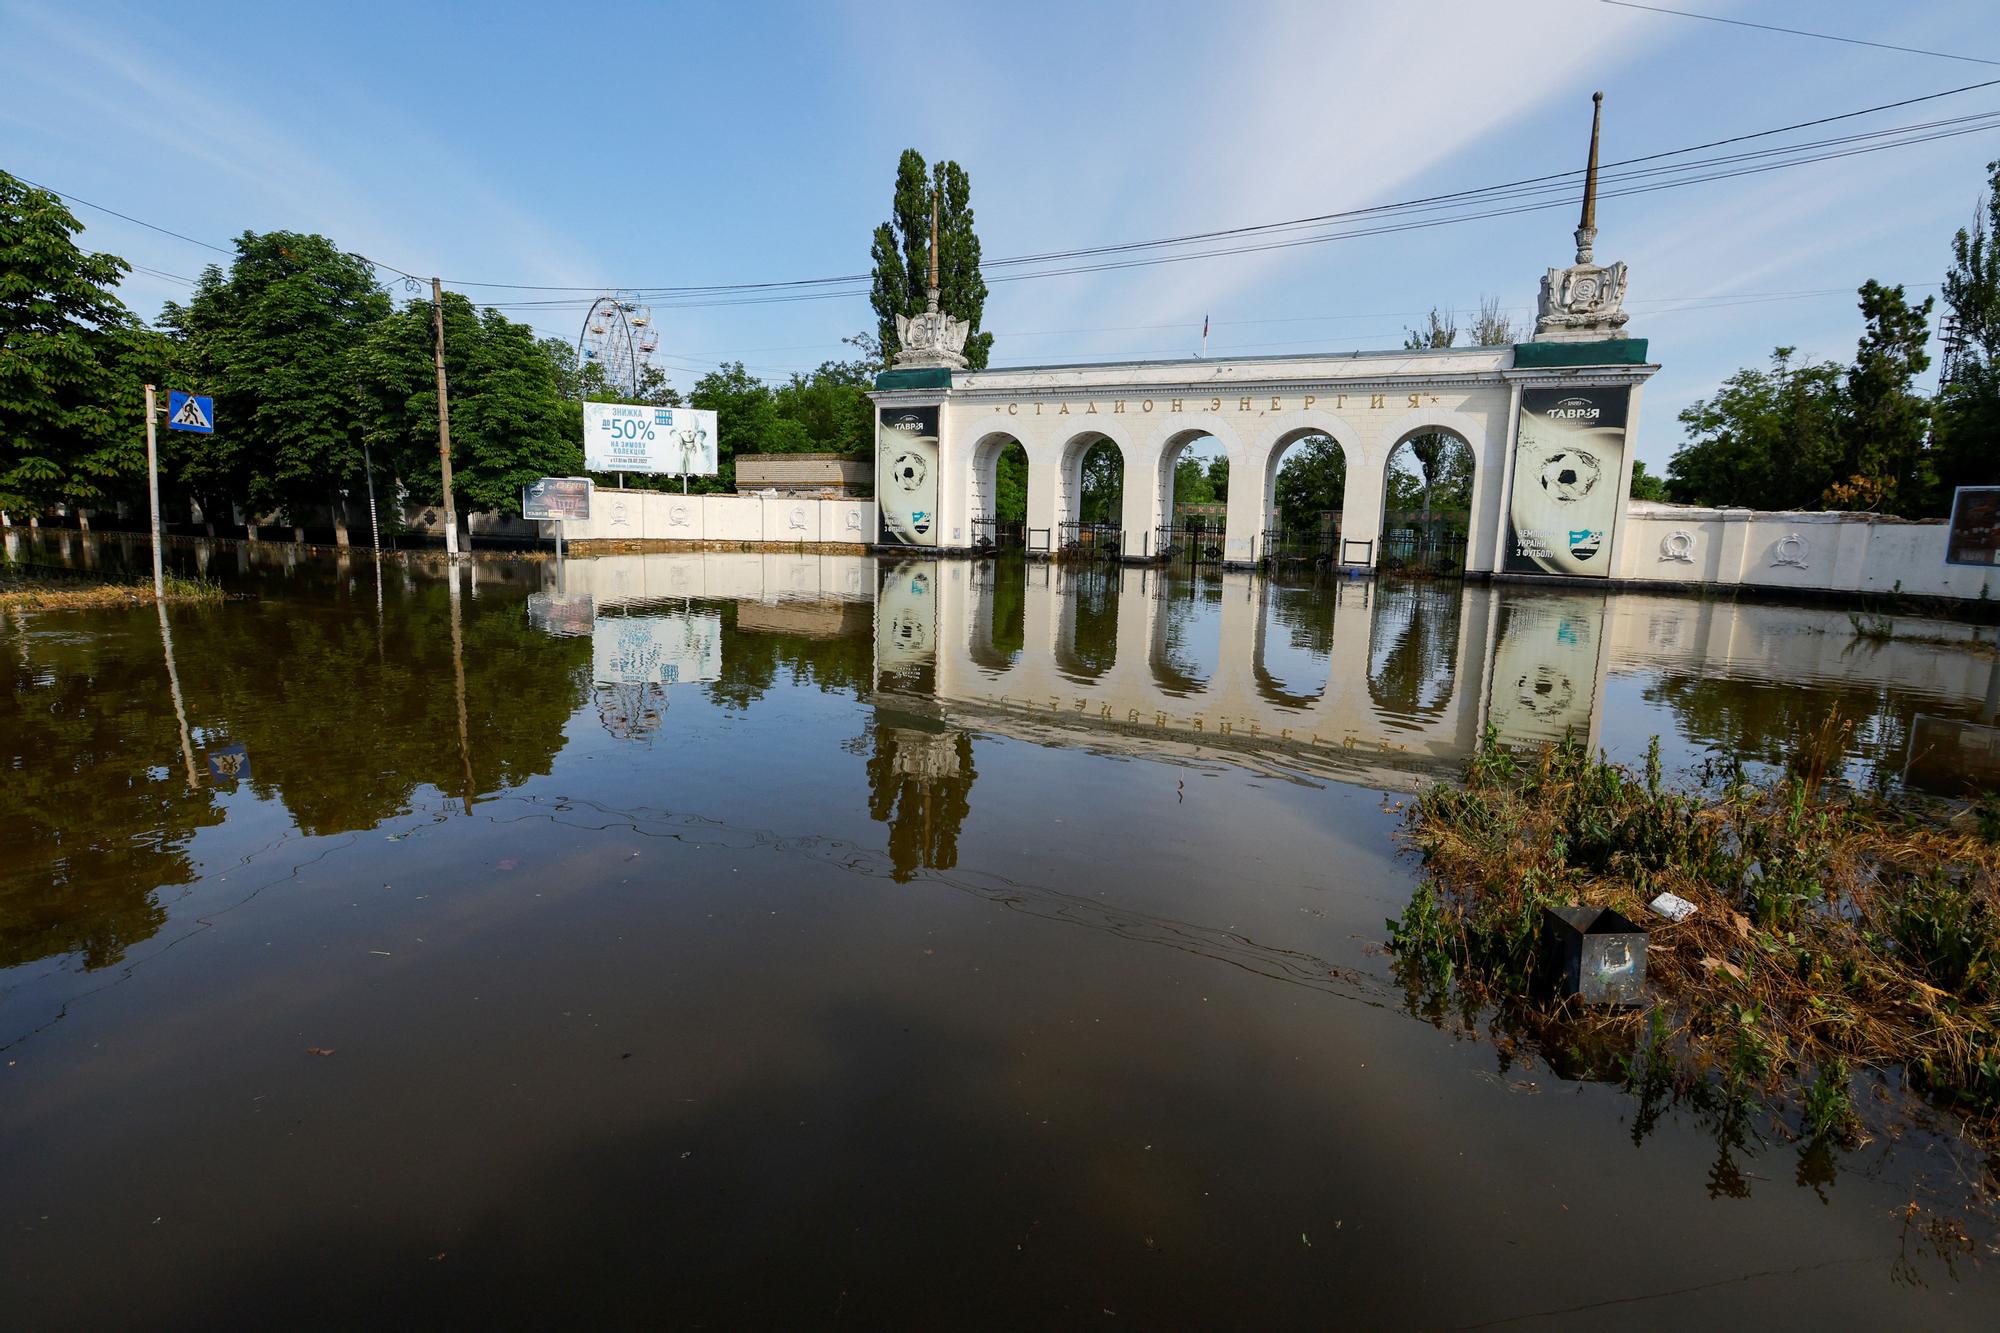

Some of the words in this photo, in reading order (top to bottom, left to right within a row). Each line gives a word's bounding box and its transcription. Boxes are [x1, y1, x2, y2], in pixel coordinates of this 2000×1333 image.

[1008, 399, 1184, 416] СТАДИОН
[612, 408, 643, 418] ЗНИЖКА
[613, 447, 646, 456] КОЛЕКЦІЮ
[1522, 549, 1555, 558] ФУТБОЛУ
